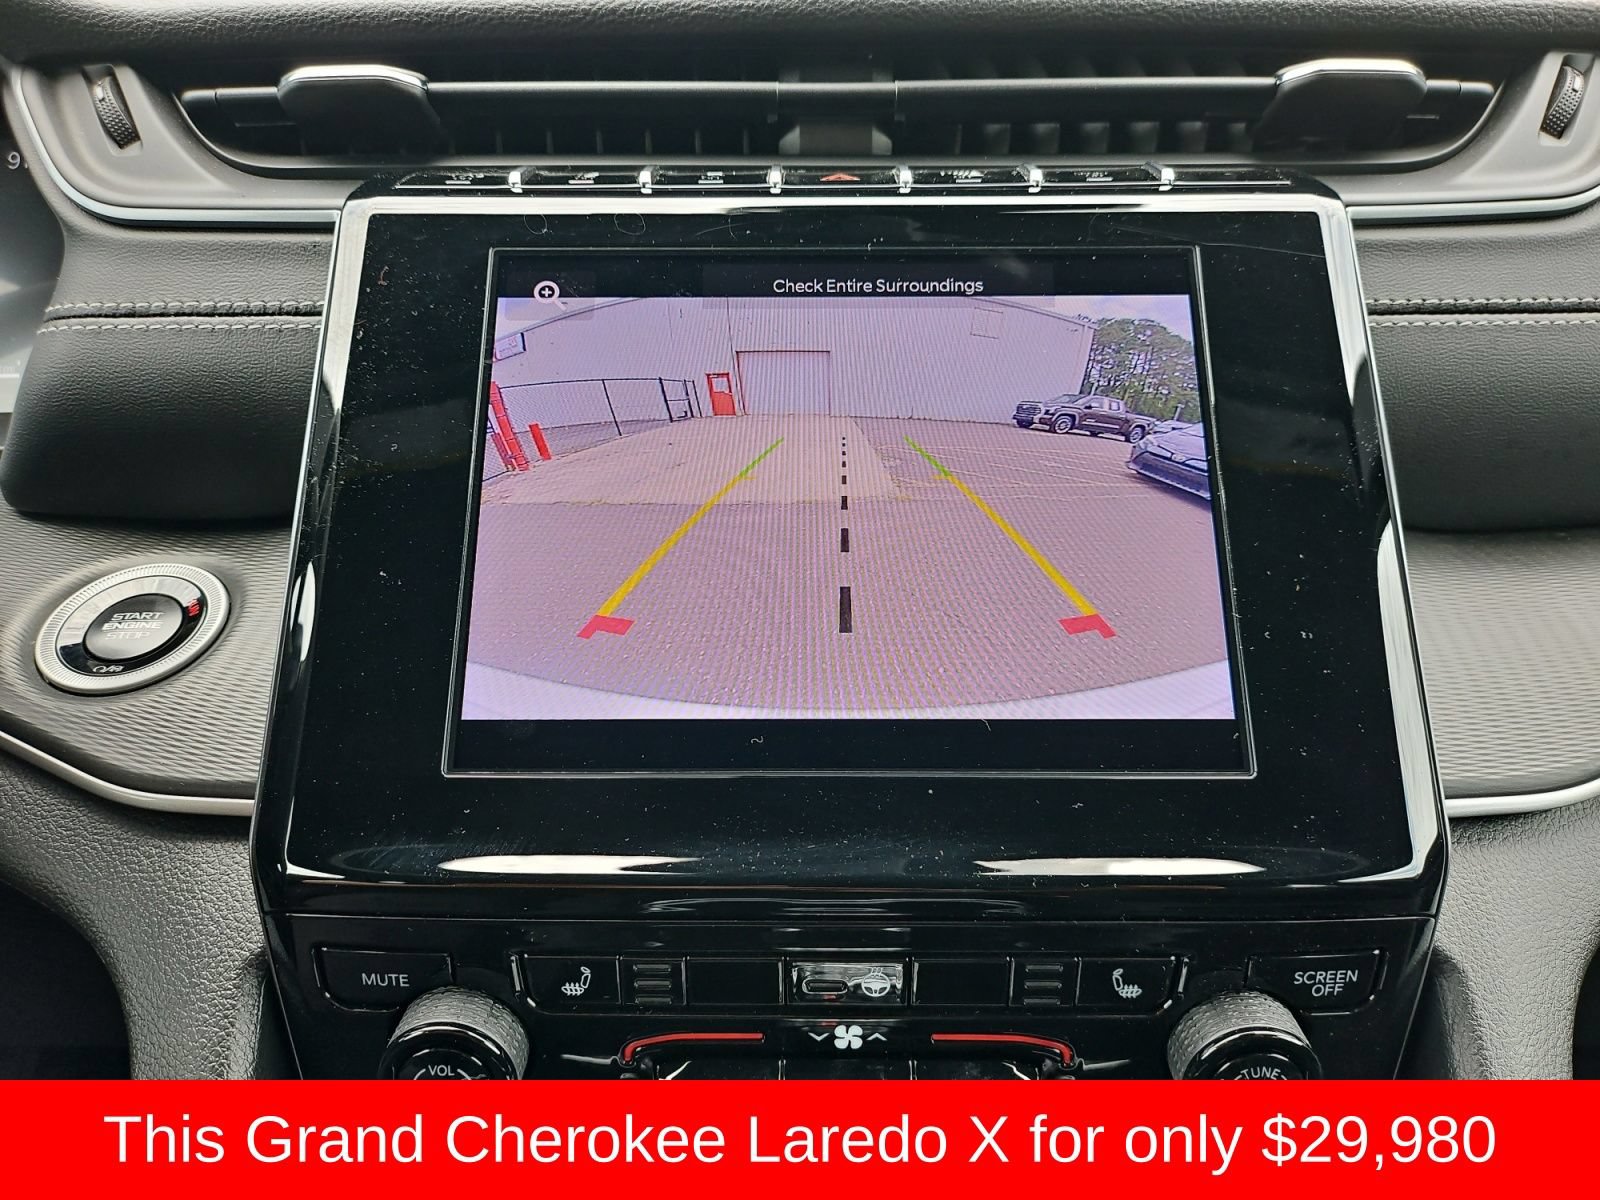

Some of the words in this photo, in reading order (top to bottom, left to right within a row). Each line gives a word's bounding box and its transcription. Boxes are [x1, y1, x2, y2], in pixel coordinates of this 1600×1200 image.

[773, 278, 823, 293] Check
[827, 278, 873, 293] Entire
[876, 278, 984, 295] Surroundings
[111, 611, 166, 621] START
[102, 621, 164, 631] ENGINE
[361, 972, 410, 987] MUTE
[1293, 969, 1359, 985] SCREEN
[1311, 983, 1345, 997] OFF
[428, 1064, 455, 1077] VOL
[1240, 1066, 1281, 1080] TUNE
